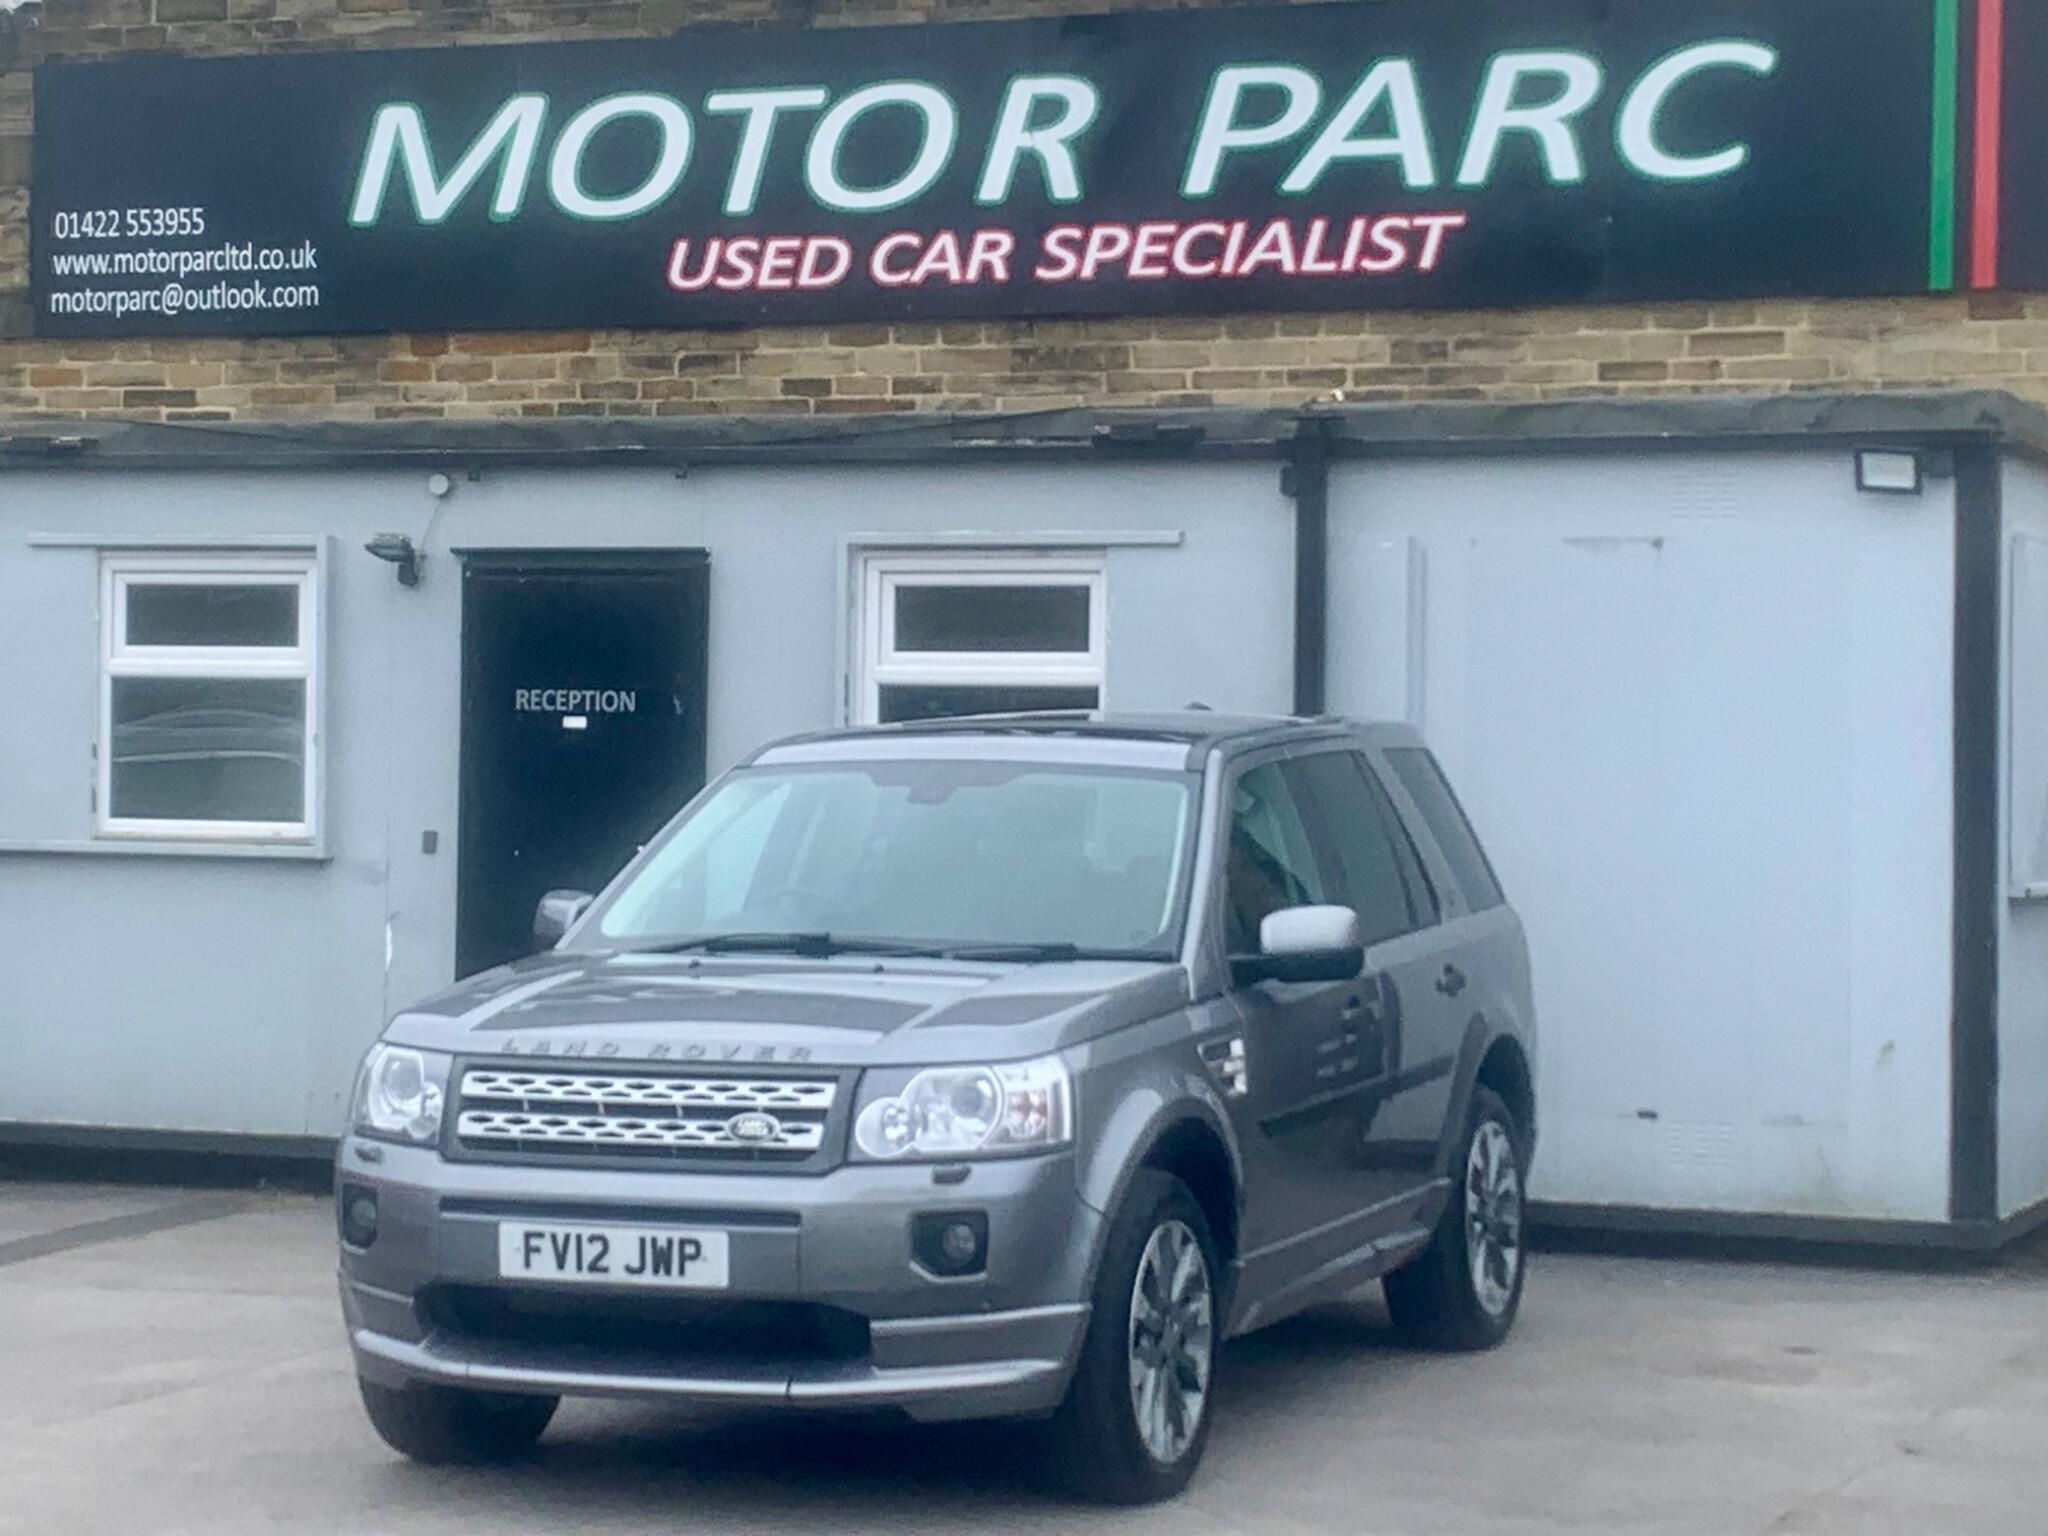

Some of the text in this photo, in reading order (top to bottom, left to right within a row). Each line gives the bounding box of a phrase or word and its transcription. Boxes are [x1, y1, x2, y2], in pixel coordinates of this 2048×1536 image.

[349, 39, 1778, 226] MOTOR PARC
[54, 207, 206, 239] 01422 553955
[52, 239, 318, 279] www.motorparcltd.co.uk
[667, 213, 1466, 292] USED CAR SPECIALIST
[50, 279, 320, 318] motorparc@outlook.com
[514, 688, 637, 713] RECEPTION
[501, 1038, 813, 1062] LAND ROVER
[522, 1230, 702, 1278] FV12 JWP
